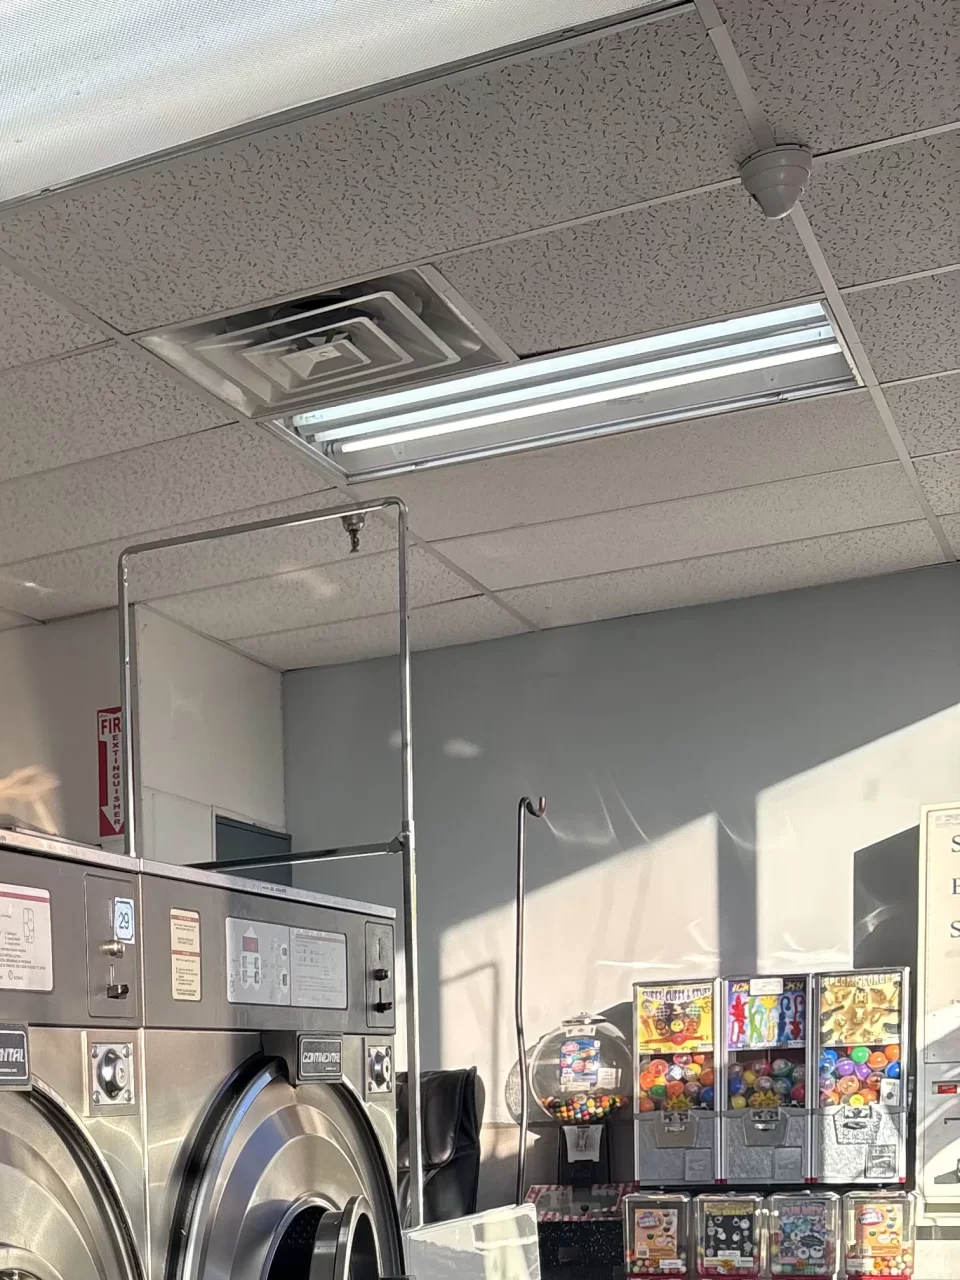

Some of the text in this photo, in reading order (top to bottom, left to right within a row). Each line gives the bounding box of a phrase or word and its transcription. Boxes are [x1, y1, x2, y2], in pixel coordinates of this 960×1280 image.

[101, 717, 121, 735] FIR
[112, 734, 121, 825] EXTINGUISHER
[119, 912, 130, 929] 29
